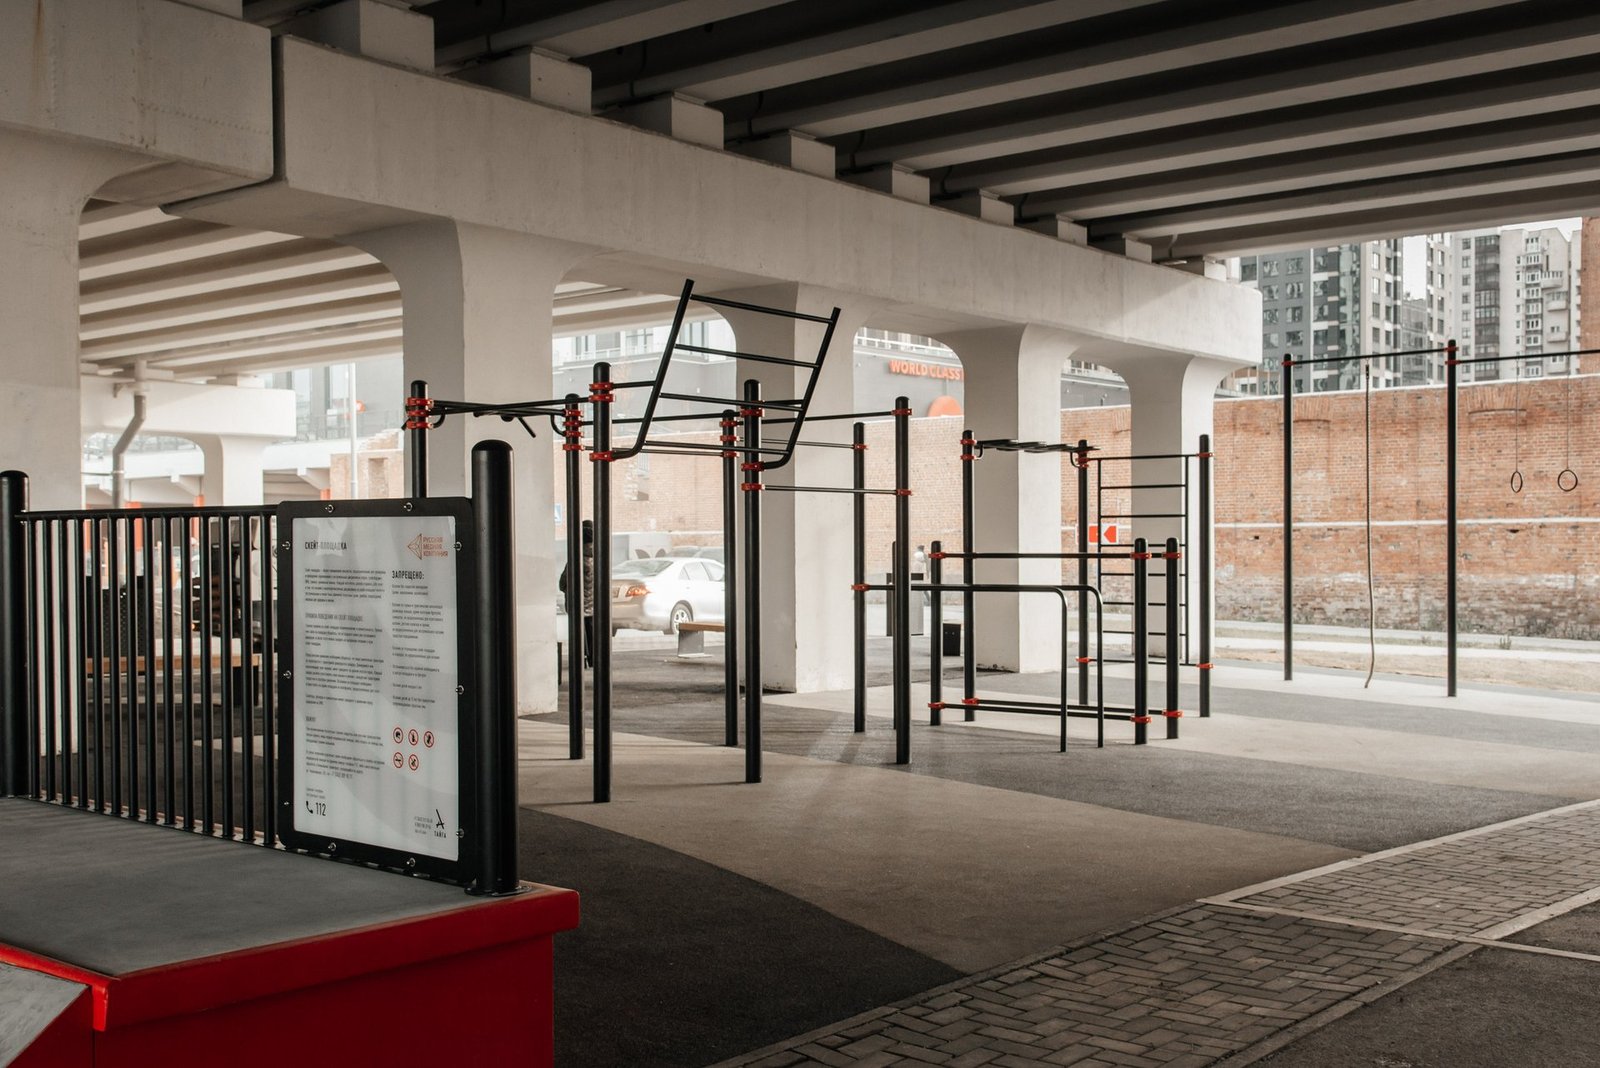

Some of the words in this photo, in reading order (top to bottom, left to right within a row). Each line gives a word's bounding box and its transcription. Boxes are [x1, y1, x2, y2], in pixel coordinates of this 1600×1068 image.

[890, 360, 928, 375] WORLD
[928, 366, 961, 380] CLASS
[392, 570, 425, 580] ЗАПРЕЩЕНО:
[315, 802, 326, 816] 112
